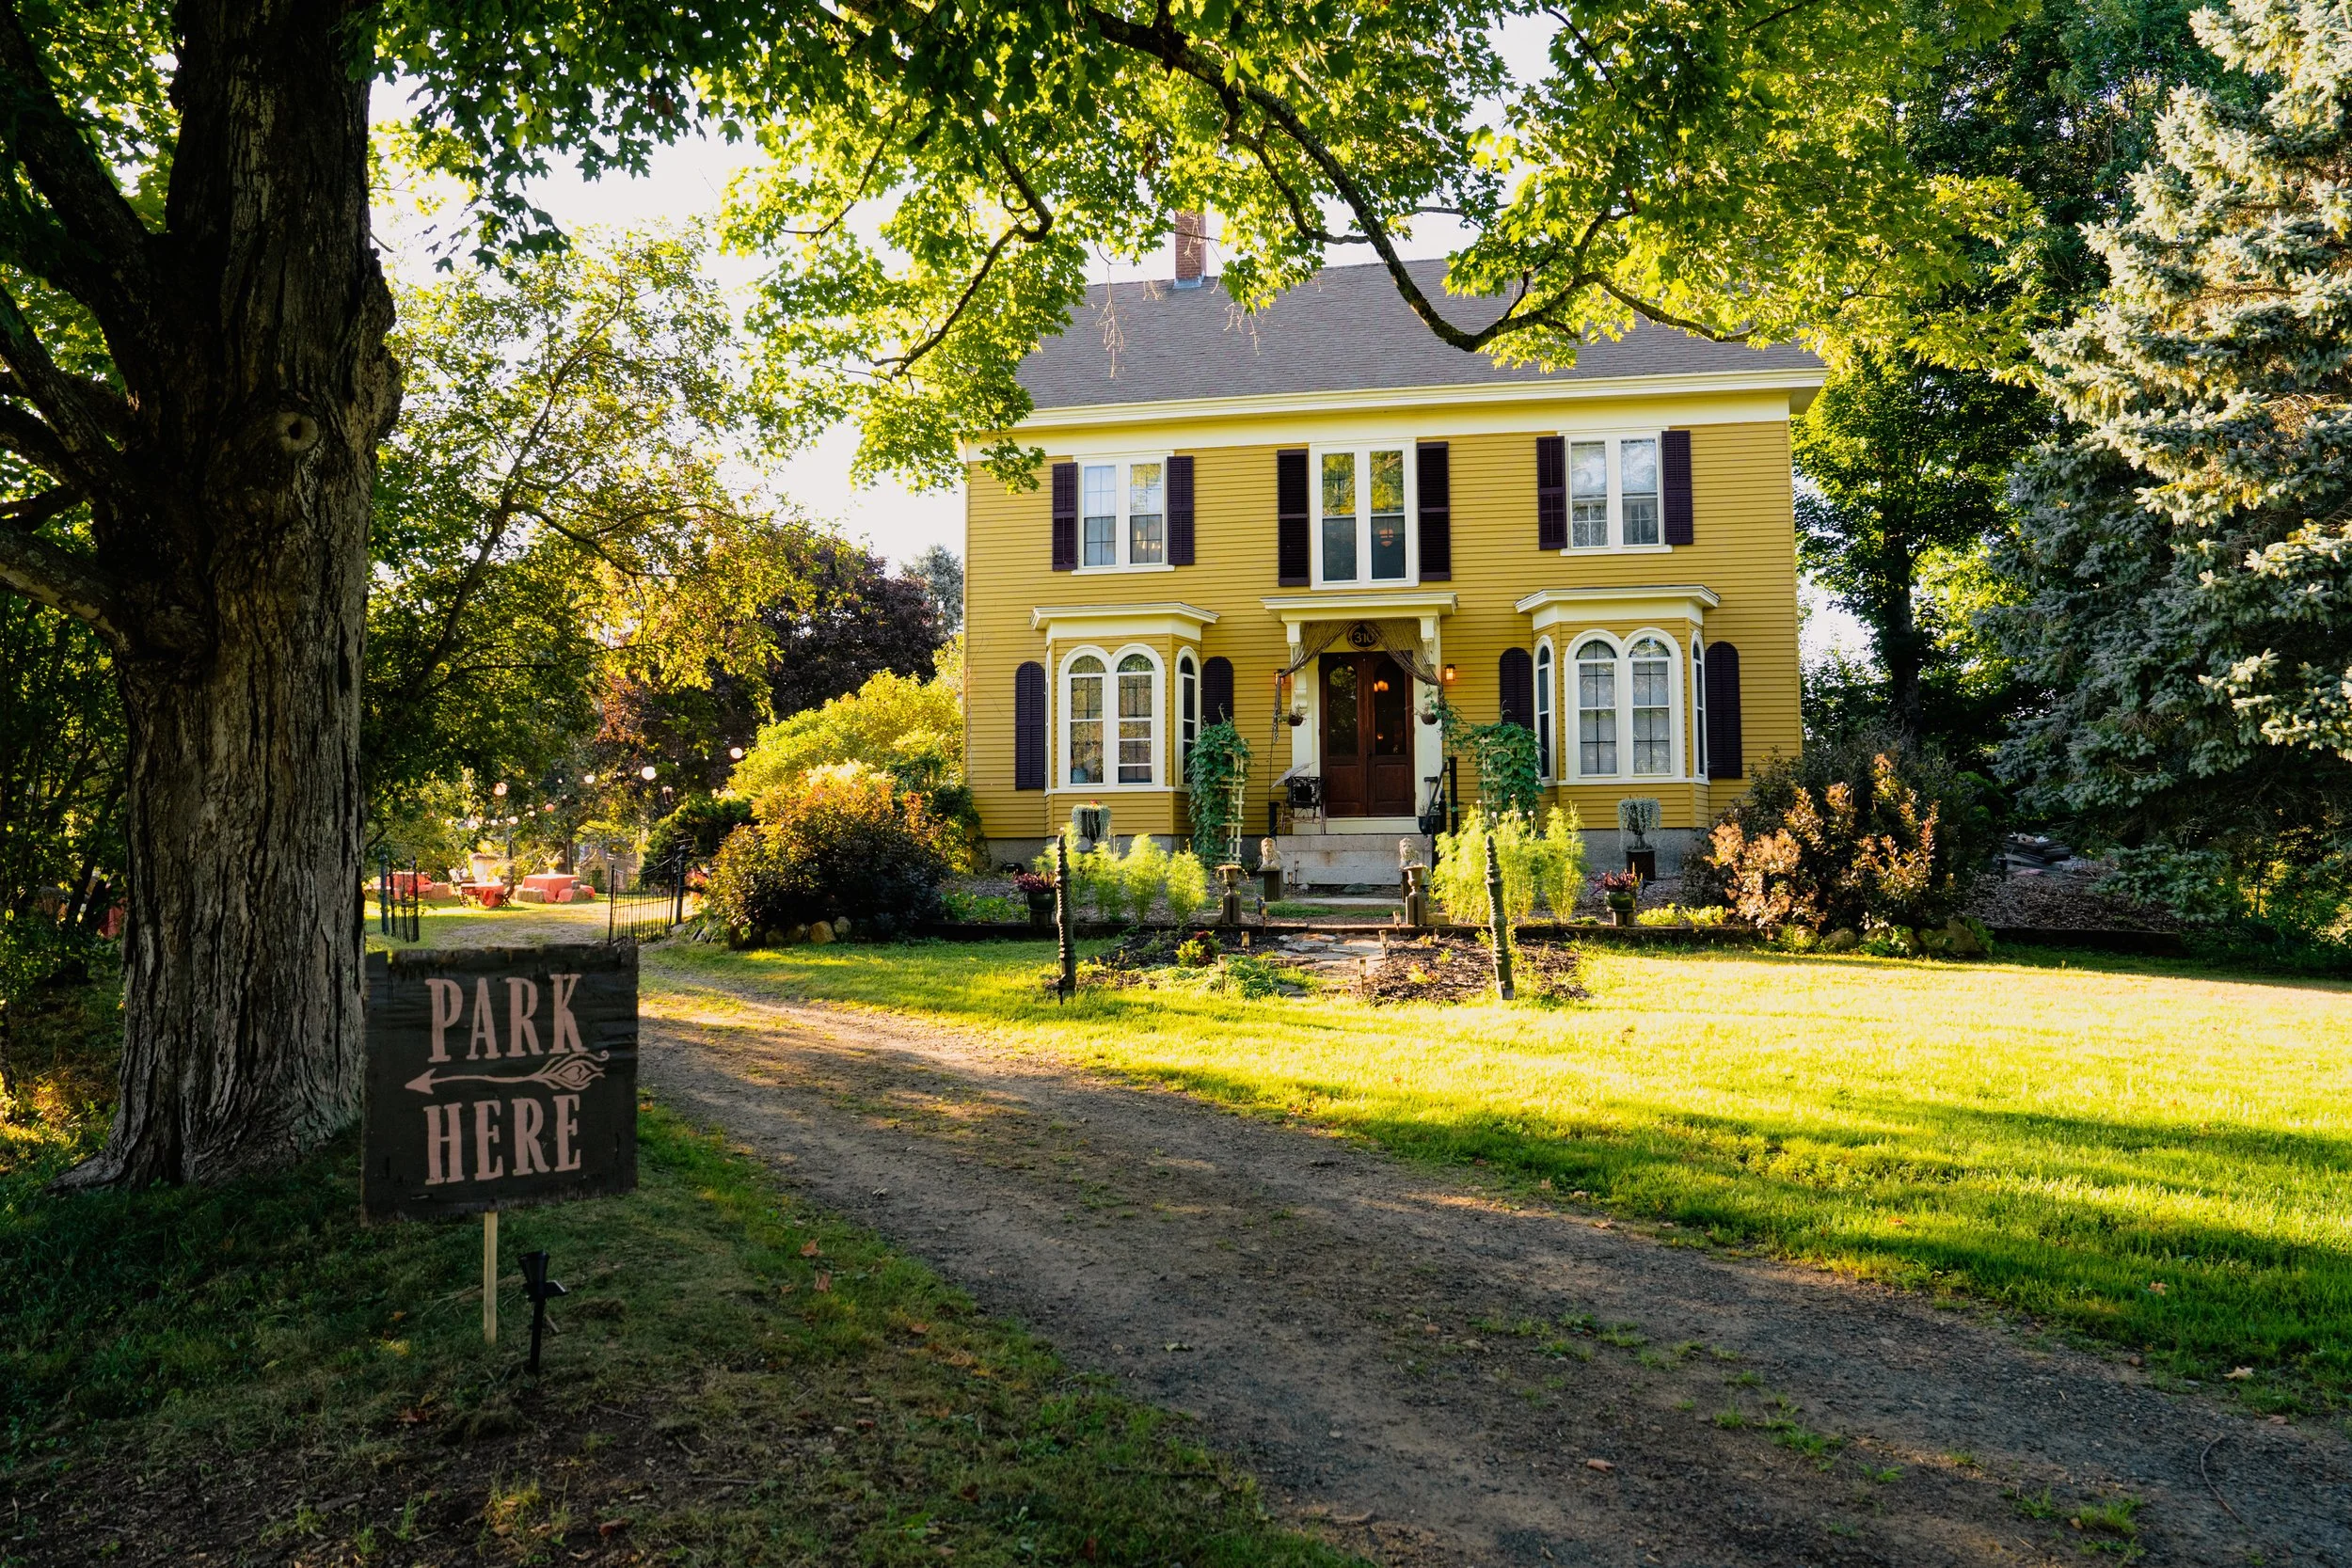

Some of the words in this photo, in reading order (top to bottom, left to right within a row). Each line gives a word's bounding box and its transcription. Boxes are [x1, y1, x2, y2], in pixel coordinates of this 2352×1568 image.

[1355, 632, 1375, 642] 310
[424, 974, 588, 1062] PARK
[423, 1094, 581, 1185] HERE
